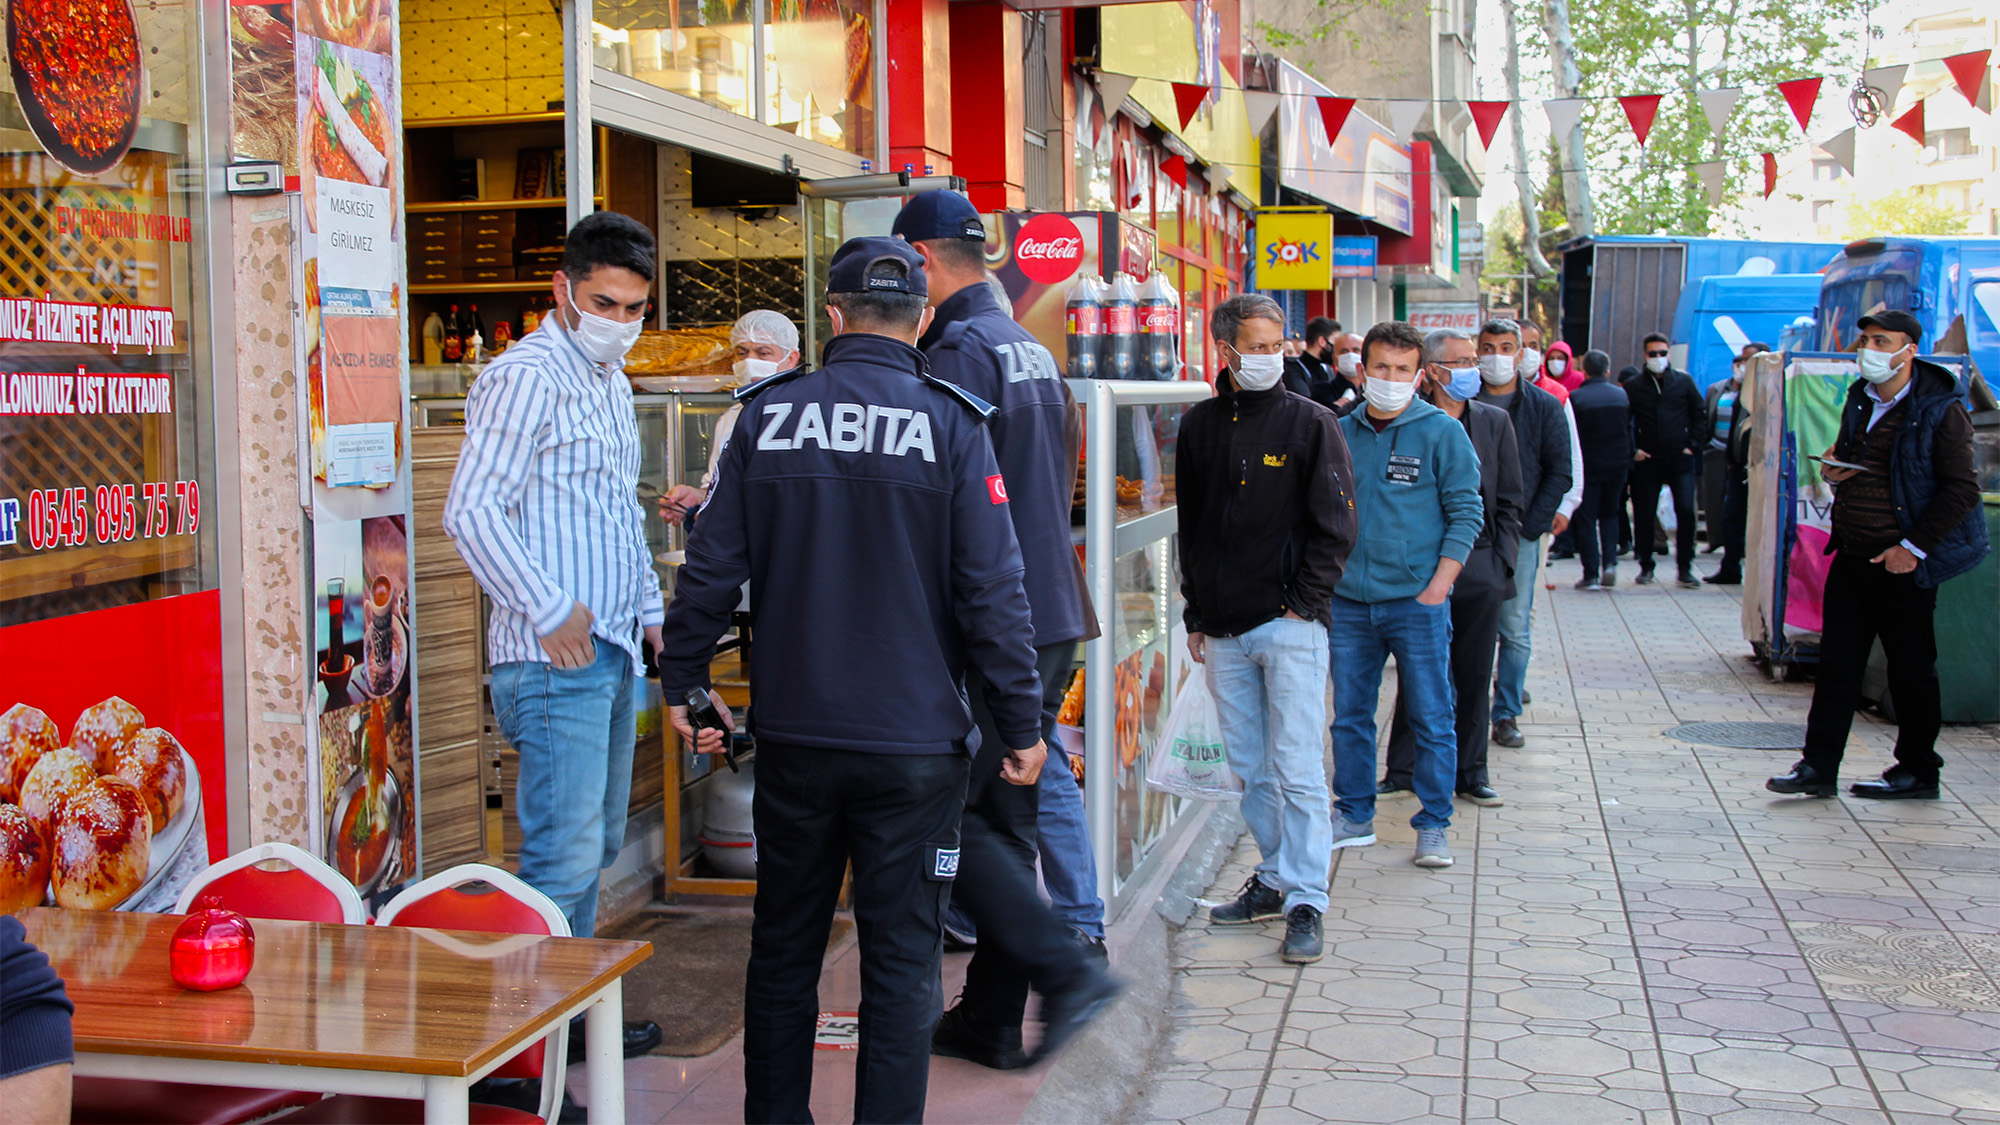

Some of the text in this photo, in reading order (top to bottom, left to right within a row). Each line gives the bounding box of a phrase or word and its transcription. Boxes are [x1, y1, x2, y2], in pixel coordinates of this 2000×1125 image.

[330, 197, 375, 218] MASKESİZ
[57, 202, 192, 243] EV PİŞİRİMİ YAPILIR
[331, 230, 373, 252] GİRİLMEZ
[1018, 237, 1081, 259] Coca-Cola
[1266, 241, 1320, 269] ŞOK
[870, 278, 899, 288] ZABITA
[35, 292, 99, 343] HİZMETE
[101, 306, 174, 355] AÇILMIŞTIR
[1409, 313, 1477, 328] ECZANE
[330, 353, 397, 368] ASKIDA EKMEK
[0, 367, 172, 414] LONUMUZ ÜST KATTADIR
[757, 402, 936, 463] ZABITA
[29, 486, 88, 550] 0545
[95, 484, 136, 543] 895
[143, 482, 169, 538] 75
[175, 480, 199, 535] 79
